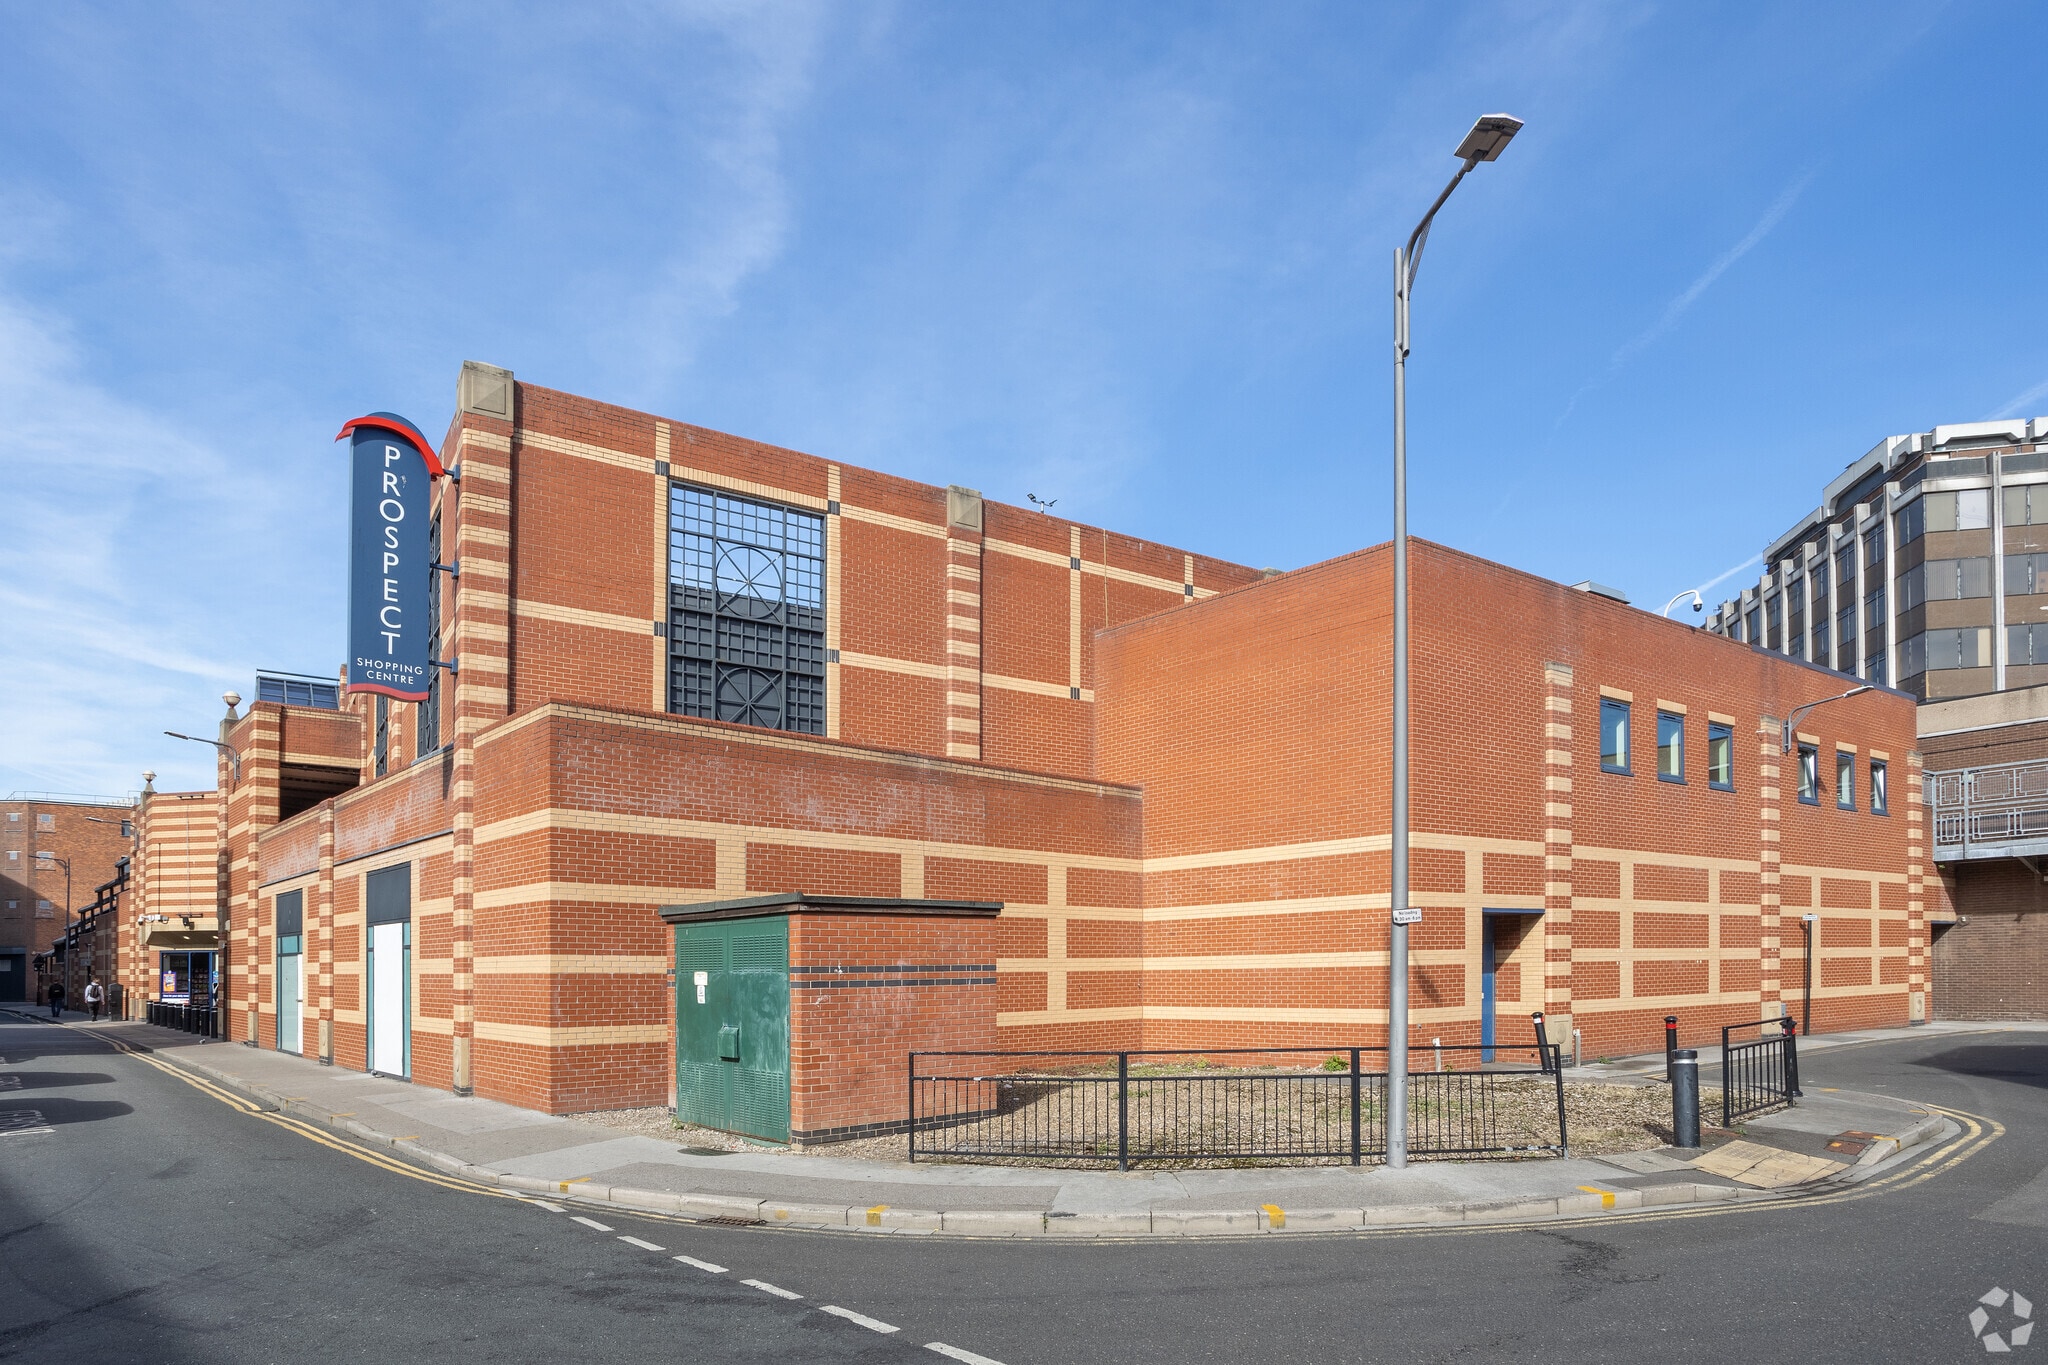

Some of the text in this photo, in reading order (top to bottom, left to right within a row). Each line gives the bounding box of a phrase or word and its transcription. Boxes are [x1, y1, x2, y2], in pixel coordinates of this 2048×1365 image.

[379, 445, 405, 655] PROSPECT
[357, 657, 423, 675] SHOPPING
[366, 670, 414, 685] CENTRE
